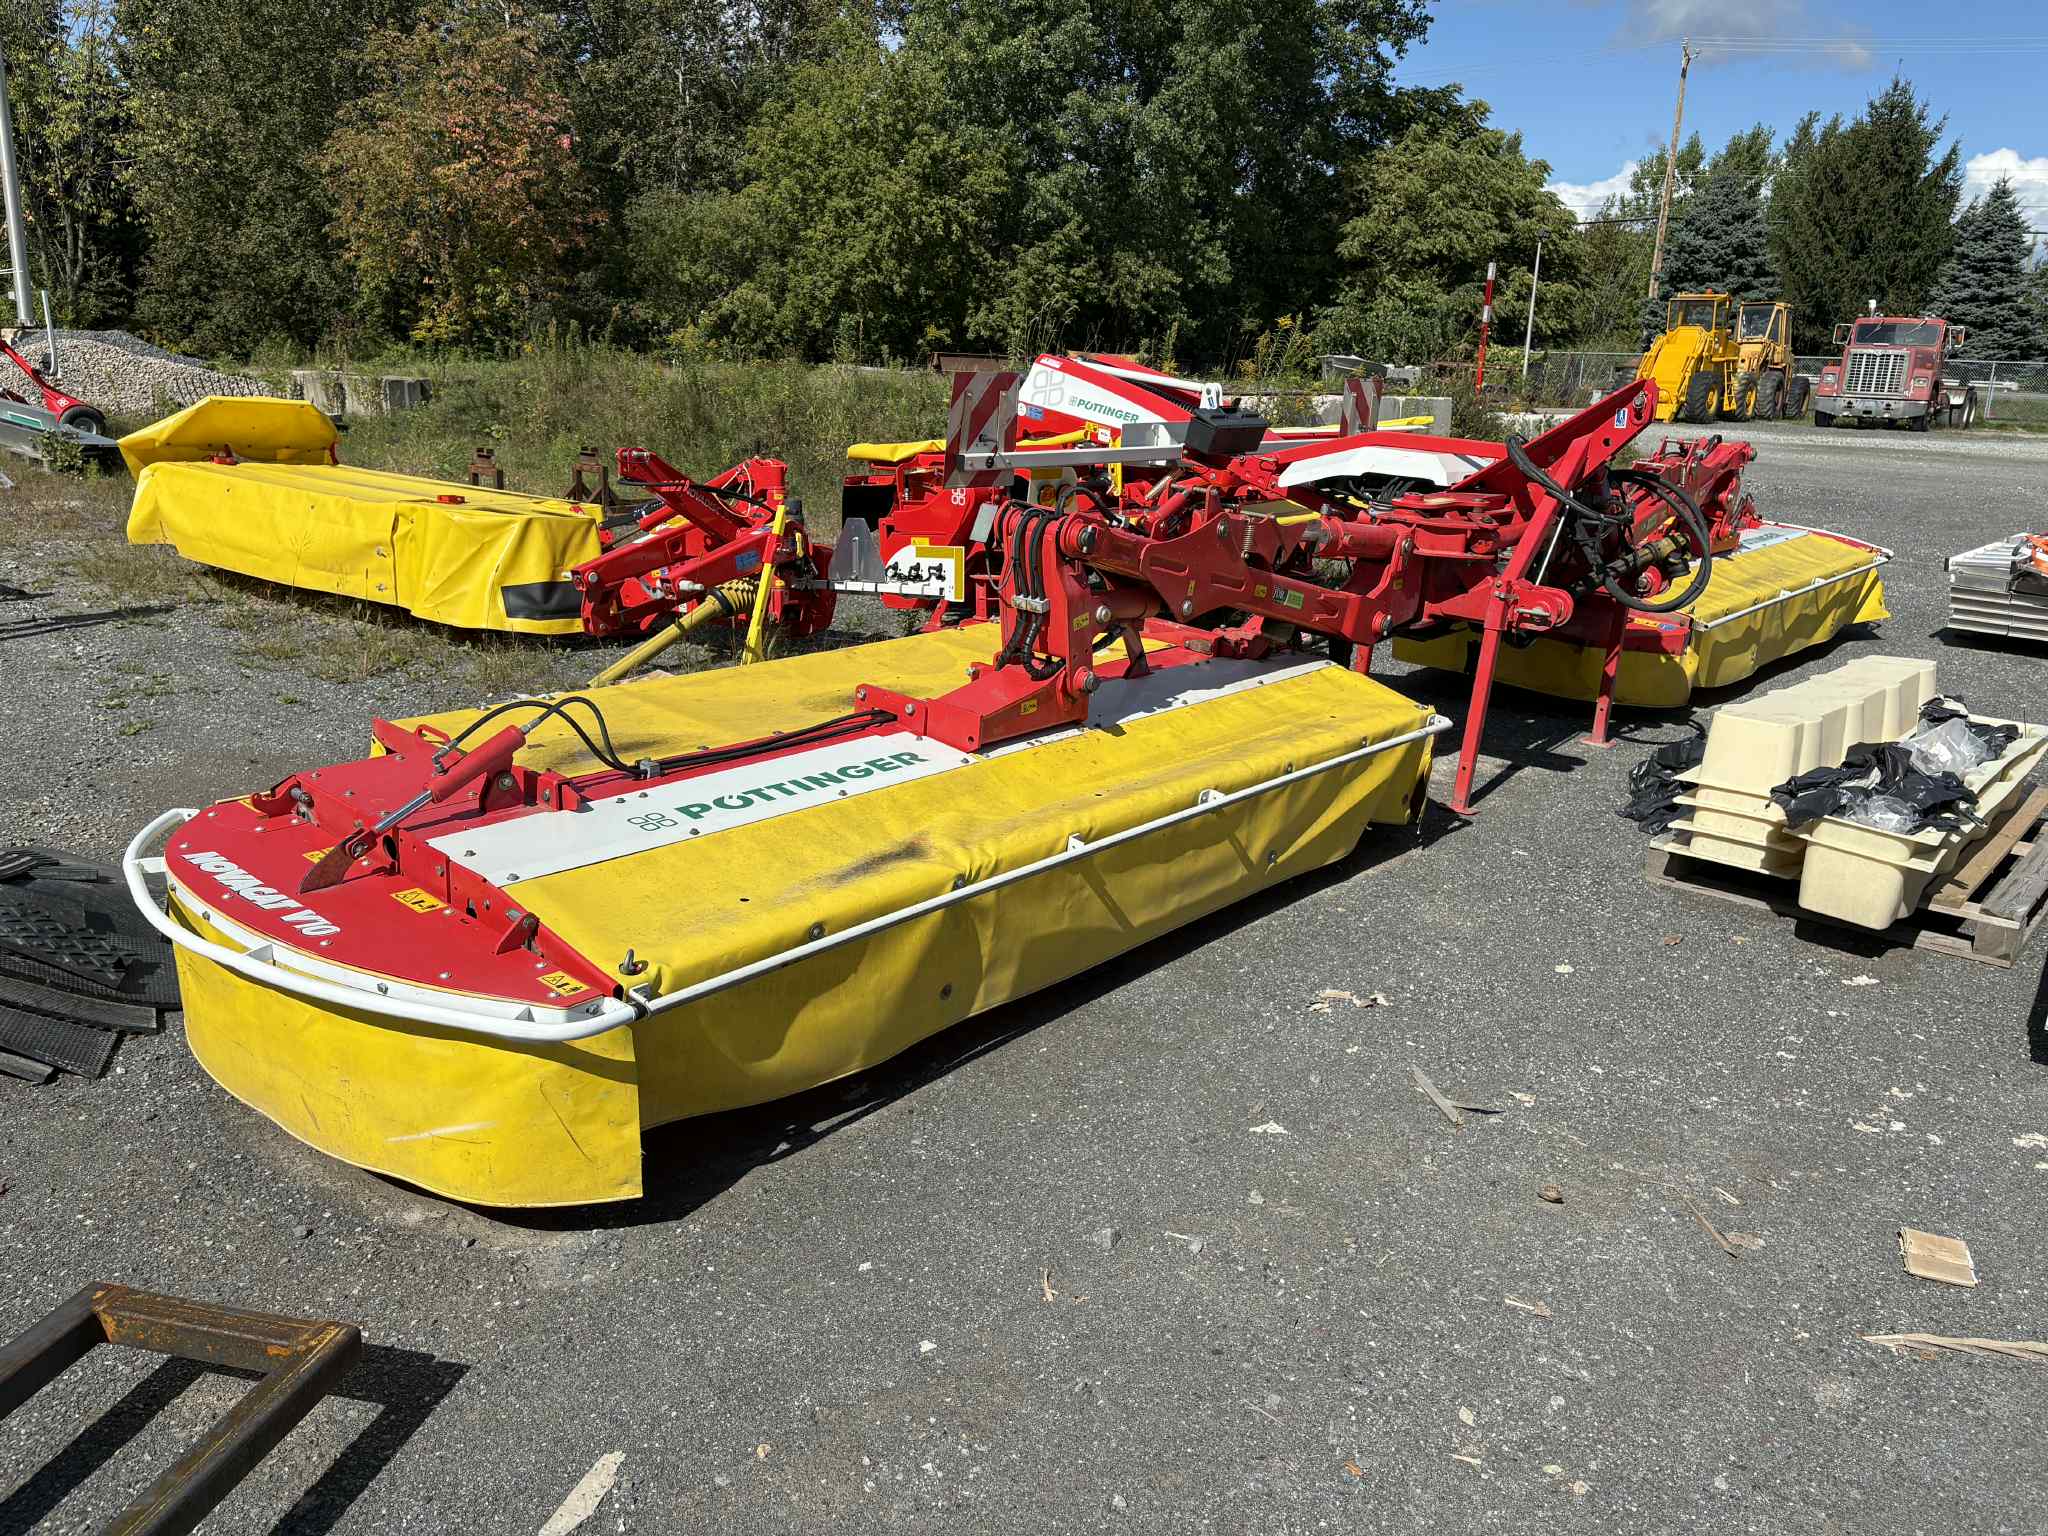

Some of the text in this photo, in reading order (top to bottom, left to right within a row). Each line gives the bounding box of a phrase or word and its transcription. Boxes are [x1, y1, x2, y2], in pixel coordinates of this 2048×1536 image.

[674, 751, 928, 820] PÖTTINGER
[180, 851, 341, 937] NOVACAT V10
